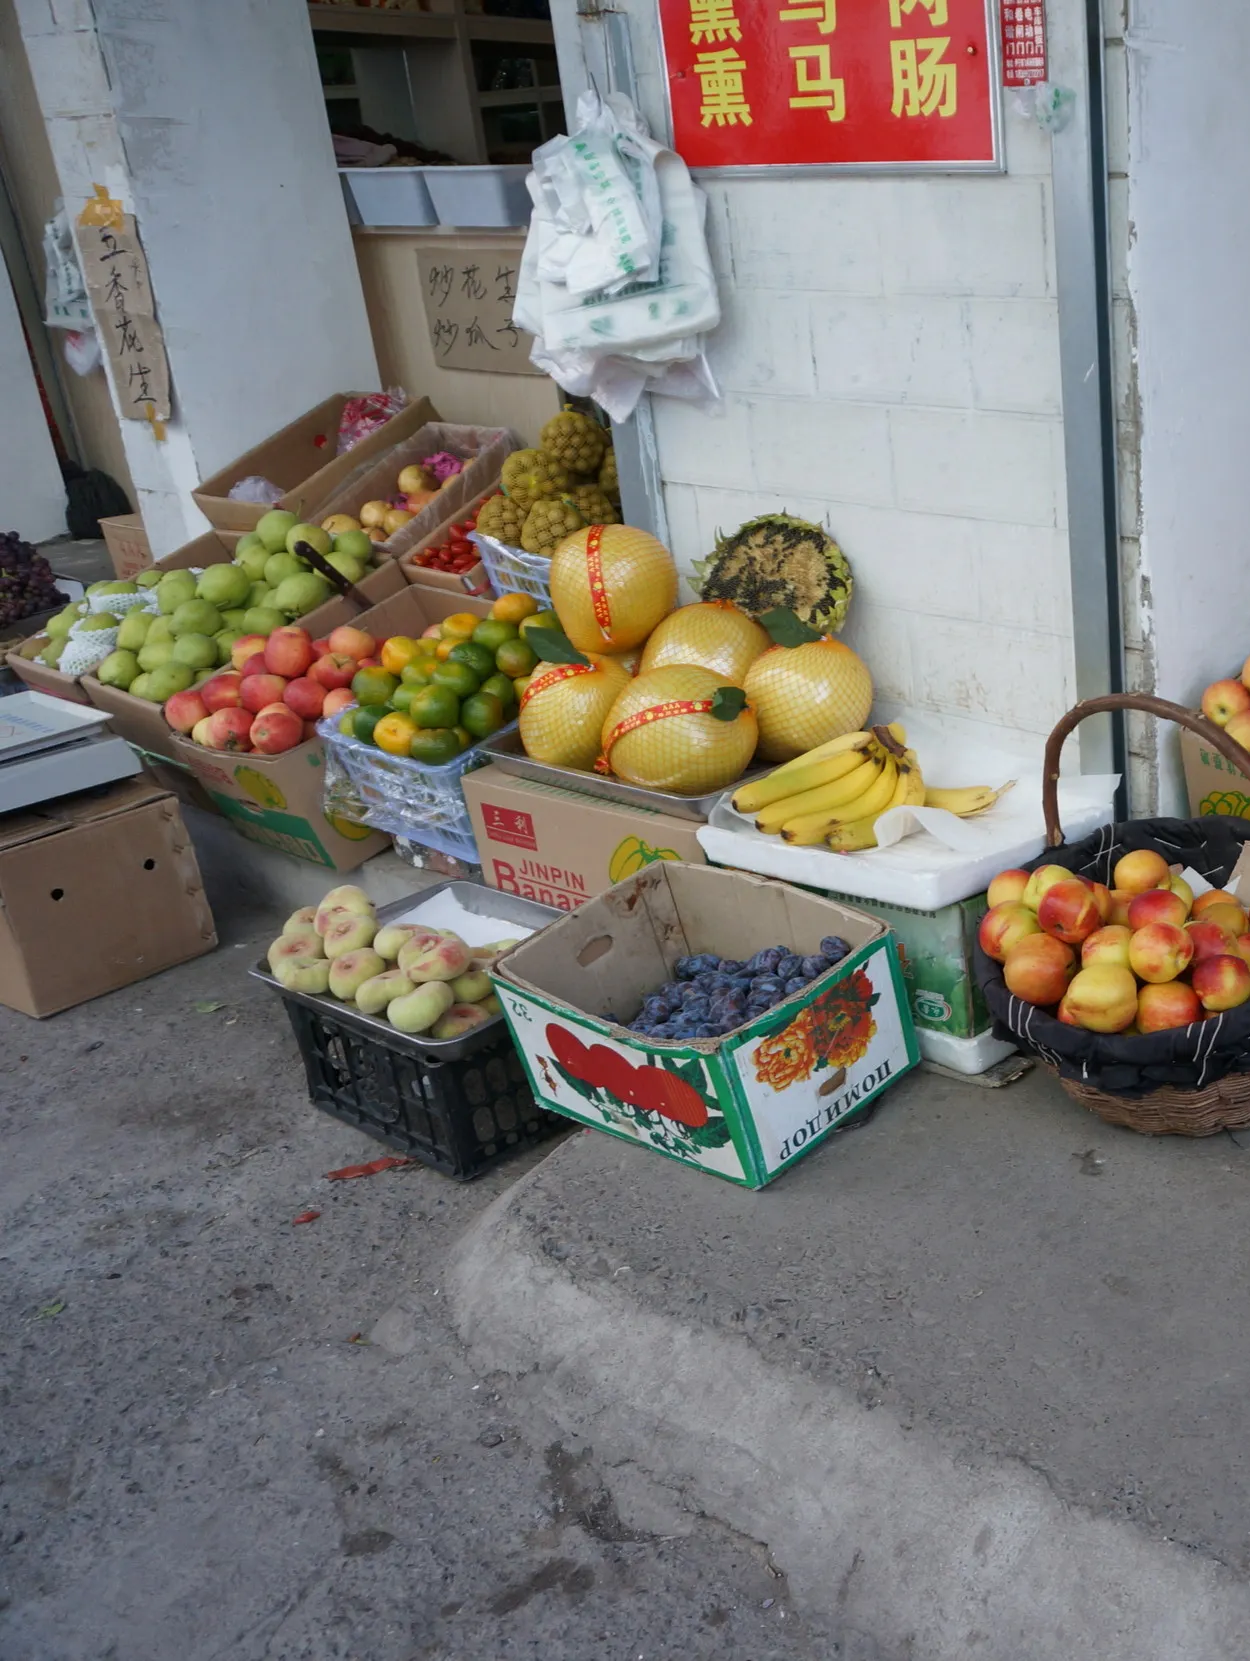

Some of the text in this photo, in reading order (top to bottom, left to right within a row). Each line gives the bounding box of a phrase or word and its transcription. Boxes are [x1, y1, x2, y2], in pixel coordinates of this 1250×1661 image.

[693, 36, 957, 128] 熏马肠
[99, 226, 157, 404] 五香花生
[492, 810, 529, 835] 三利
[492, 858, 585, 912] Bana
[519, 858, 585, 892] JINPIN
[507, 996, 533, 1022] 32
[779, 1058, 893, 1161] ПОМИДОР
